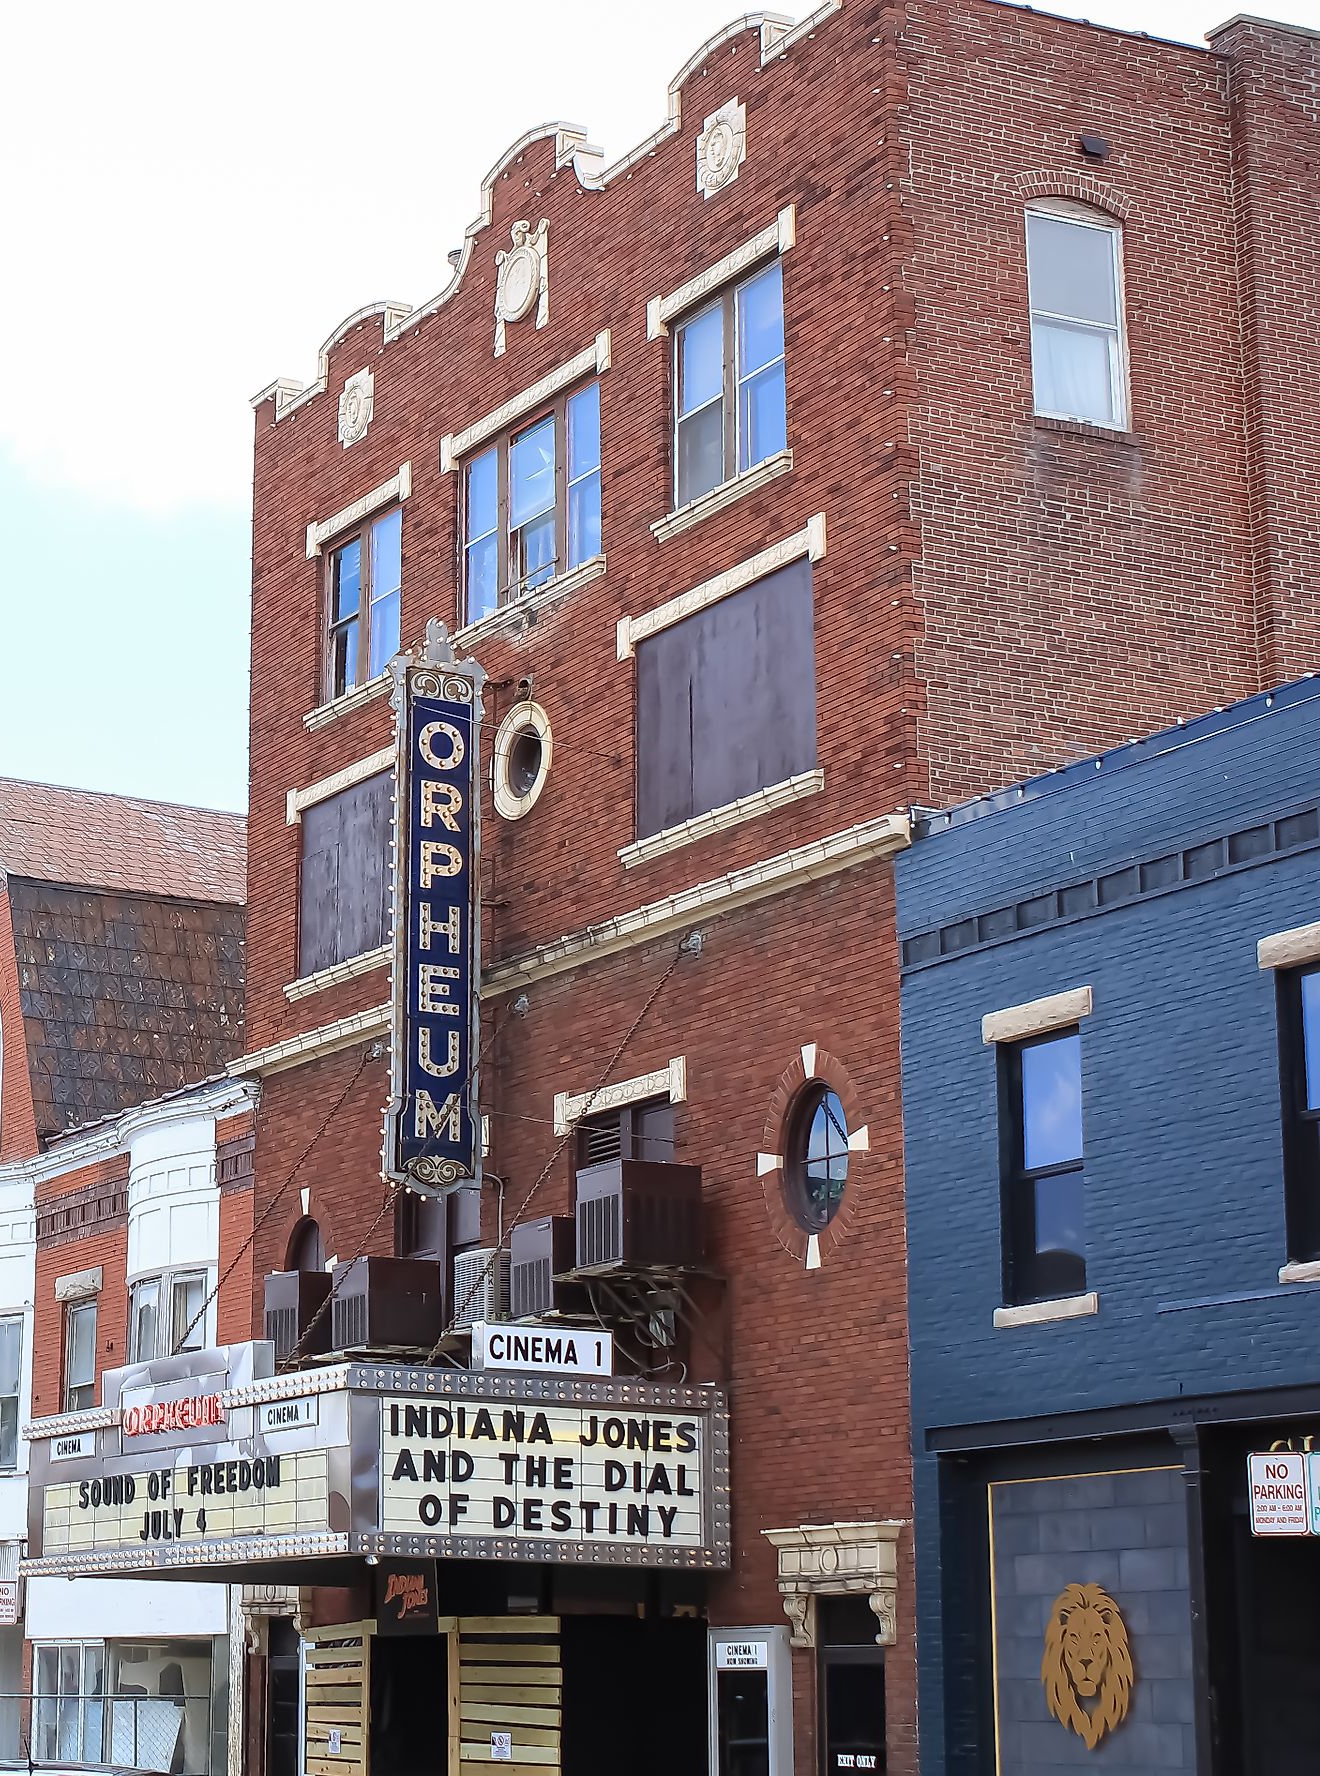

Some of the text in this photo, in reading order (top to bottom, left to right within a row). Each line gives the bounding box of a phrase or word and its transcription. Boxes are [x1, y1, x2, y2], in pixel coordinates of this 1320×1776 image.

[415, 721, 465, 1142] ORPHEUM
[489, 1334, 602, 1366] CINEMA 1
[267, 1406, 300, 1426] CINEMA
[390, 1404, 696, 1453] INDIANA JONES
[57, 1439, 81, 1456] CINEMA
[79, 1455, 281, 1509] SOUND OF FREEDOM
[391, 1448, 694, 1496] AND THE DIAL
[1265, 1464, 1288, 1479] NO
[1254, 1484, 1303, 1499] PARKING
[139, 1507, 207, 1541] JULY 4
[418, 1494, 678, 1537] OF DESTINY
[727, 1645, 751, 1656] CINEMA
[837, 1754, 876, 1768] EXIT ONLY
